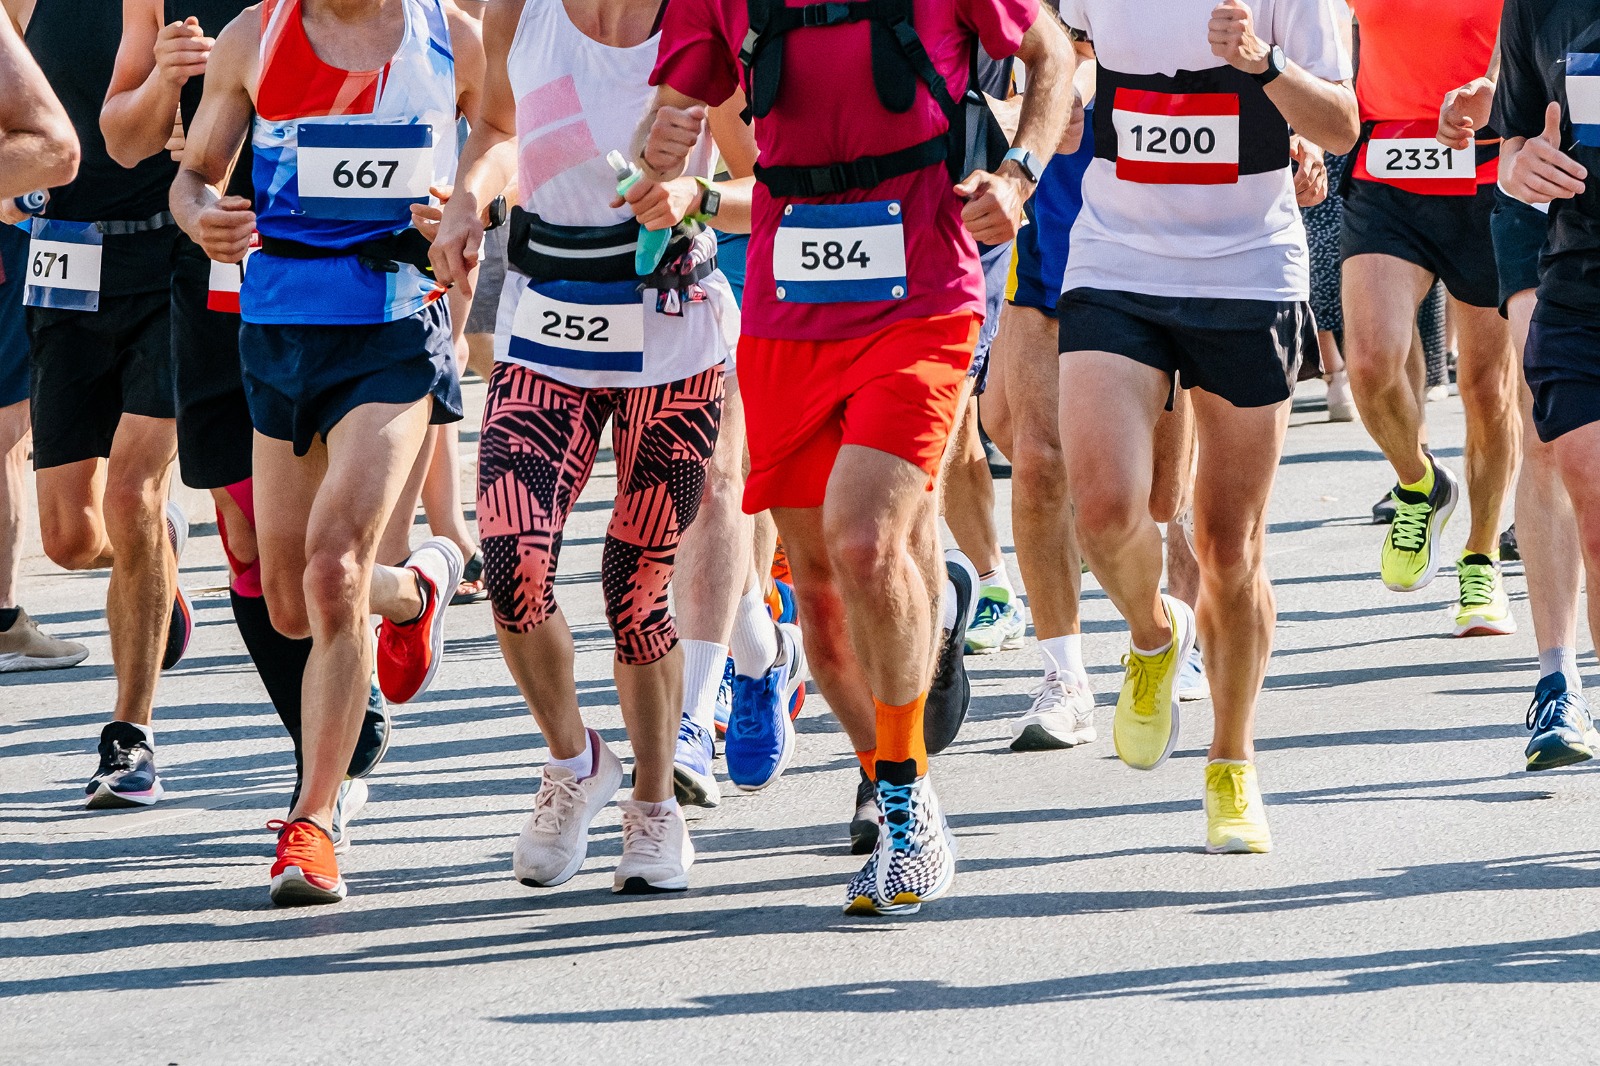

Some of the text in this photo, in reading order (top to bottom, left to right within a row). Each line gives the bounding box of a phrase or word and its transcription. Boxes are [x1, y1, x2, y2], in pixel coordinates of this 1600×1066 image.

[1131, 125, 1216, 154] 1200
[1386, 148, 1453, 170] 2331
[333, 160, 399, 189] 667
[32, 251, 69, 280] 671
[801, 240, 871, 271] 584
[541, 310, 609, 343] 252
